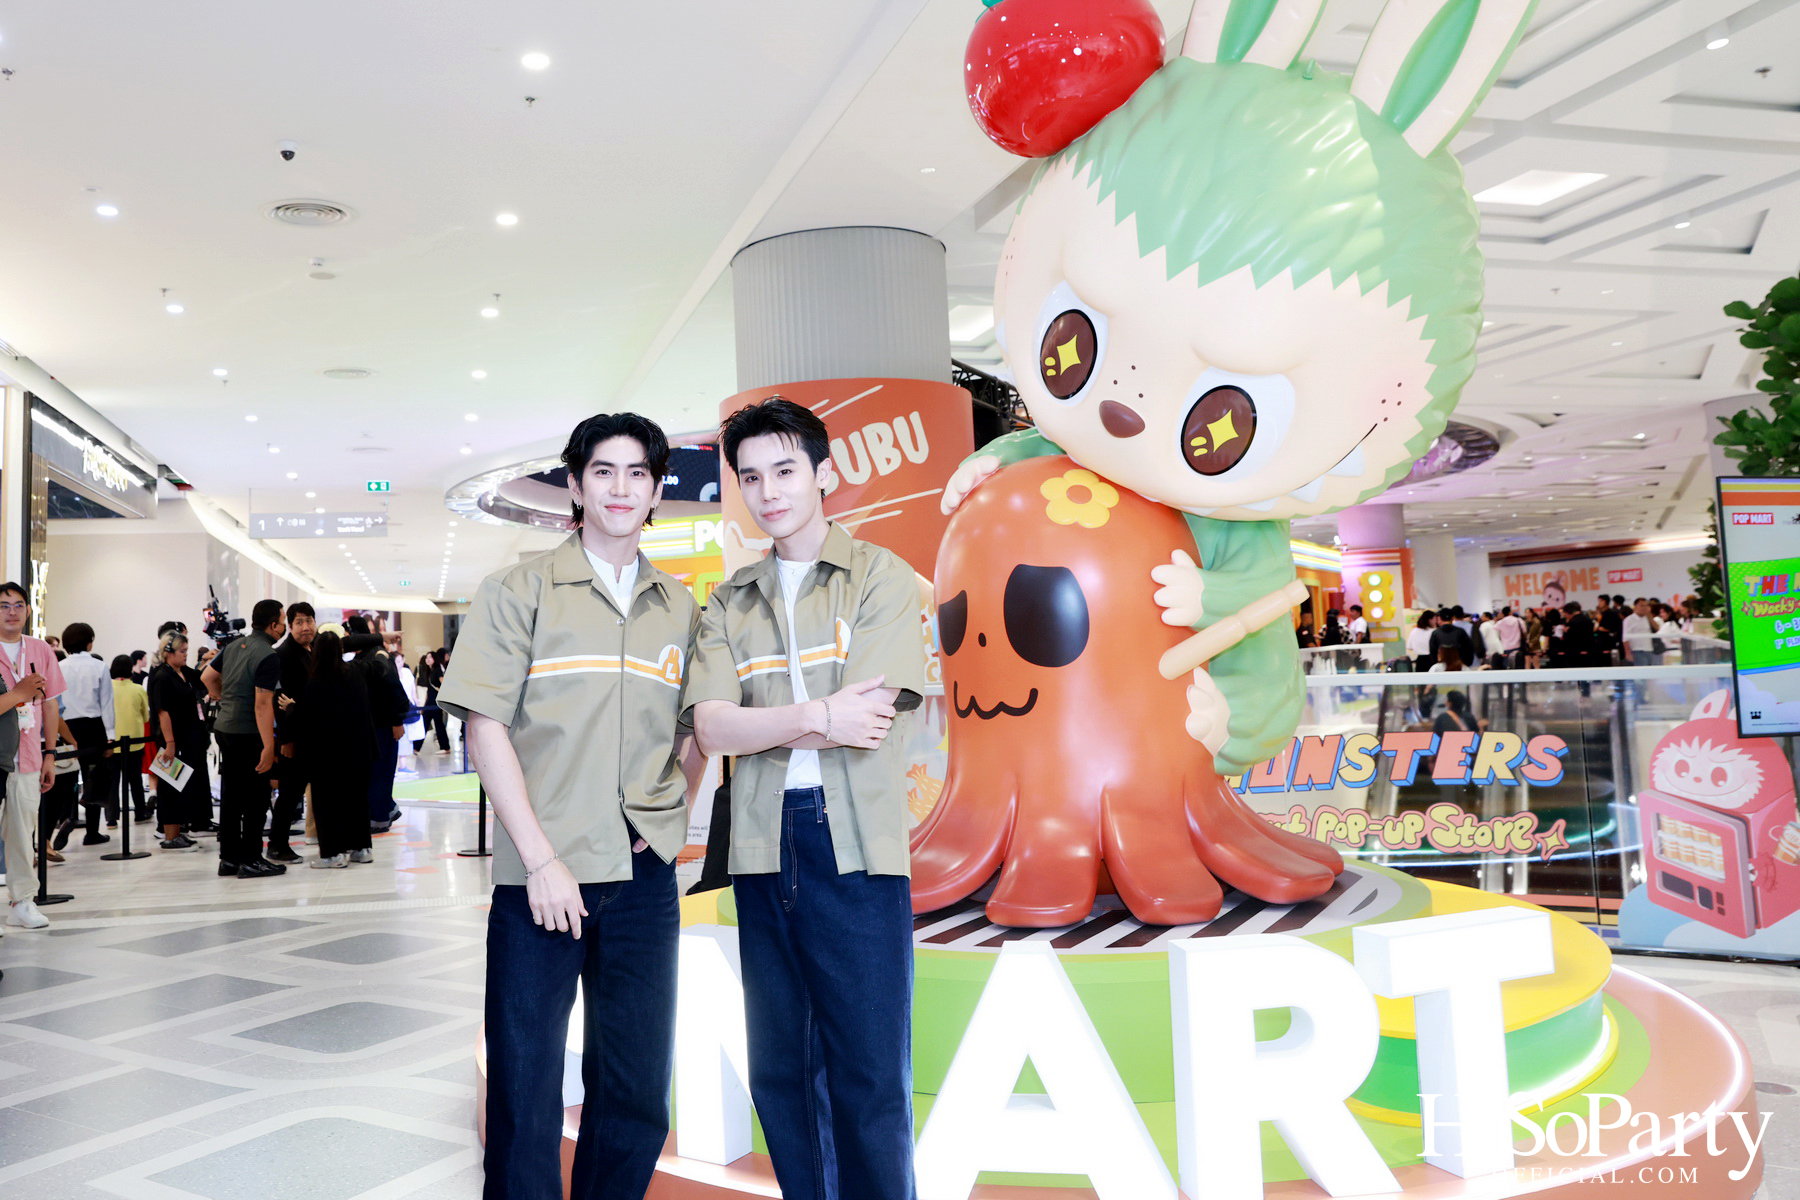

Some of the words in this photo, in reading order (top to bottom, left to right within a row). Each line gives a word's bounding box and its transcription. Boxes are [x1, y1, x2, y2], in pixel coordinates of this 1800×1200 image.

[826, 411, 929, 496] UBU
[1733, 514, 1749, 524] POP
[1750, 513, 1773, 524] MART
[1504, 567, 1601, 597] WELCOME
[1744, 573, 1790, 597] THE
[1224, 731, 1570, 794] ONSTERS
[1429, 804, 1535, 851] Store
